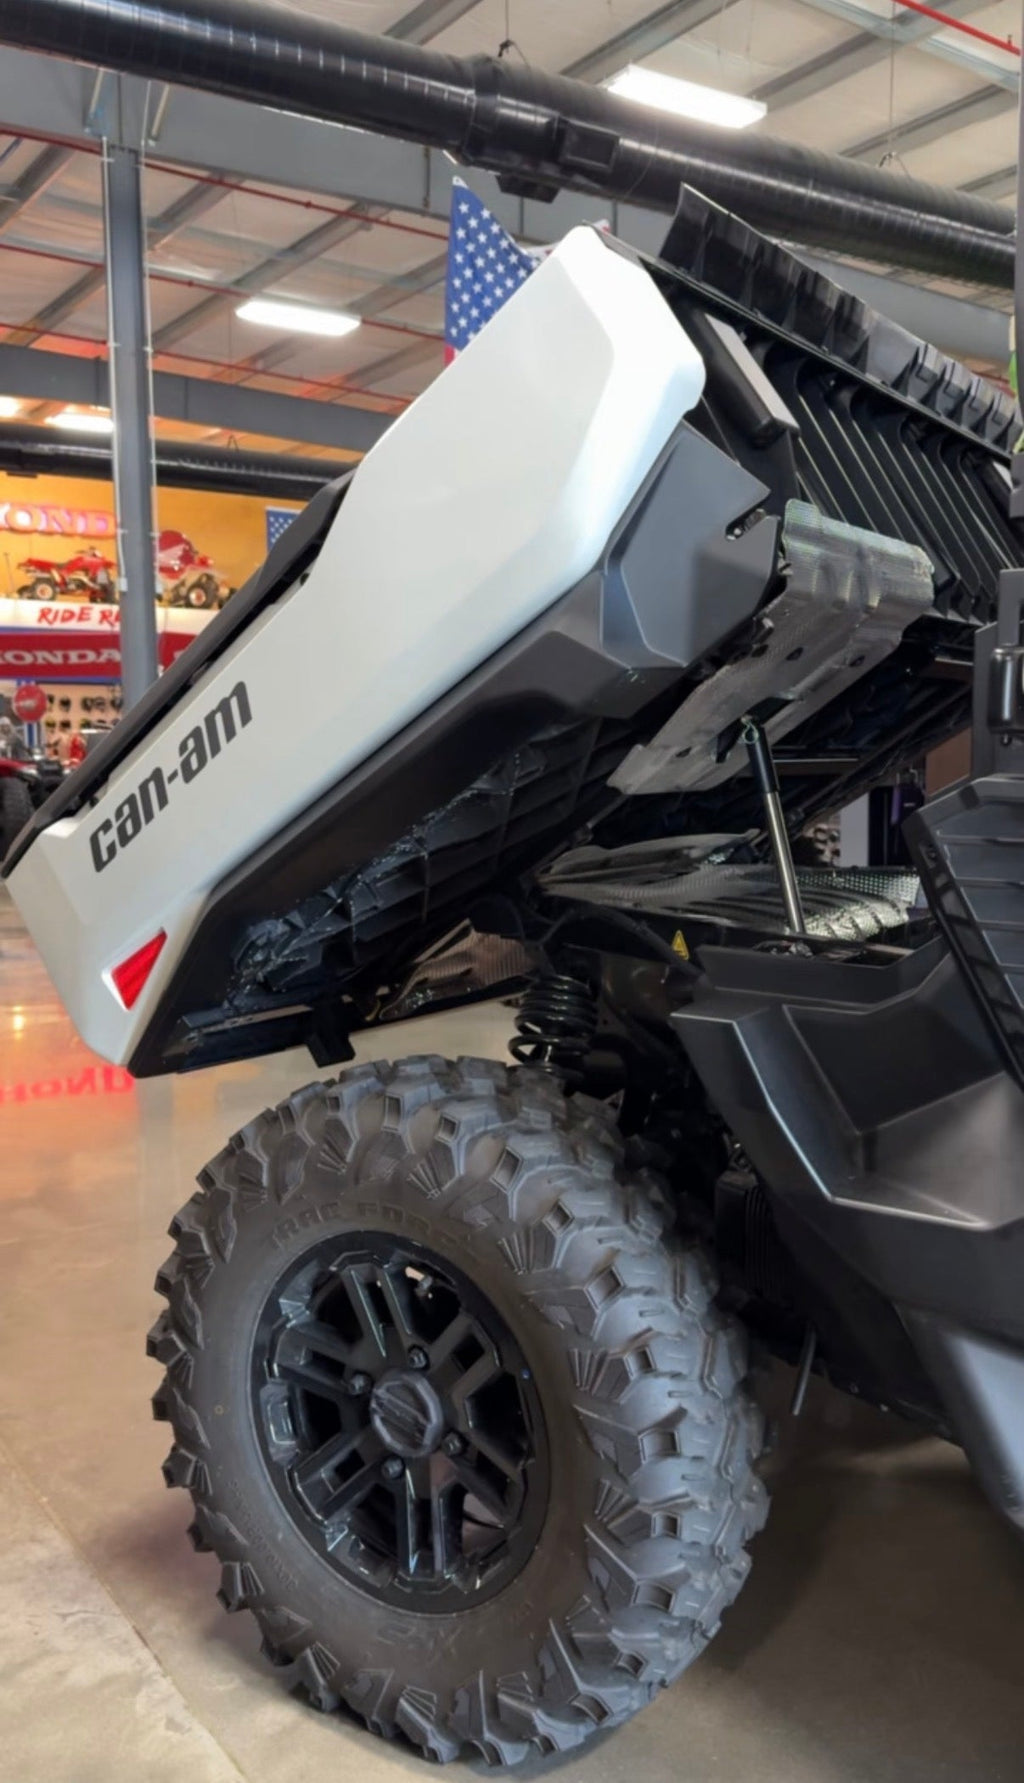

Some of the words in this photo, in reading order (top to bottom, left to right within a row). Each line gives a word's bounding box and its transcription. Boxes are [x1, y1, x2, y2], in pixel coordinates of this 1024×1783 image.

[0, 504, 117, 538] OND
[37, 606, 93, 625] RIDE
[0, 648, 121, 666] ONDA
[89, 680, 253, 873] can-am
